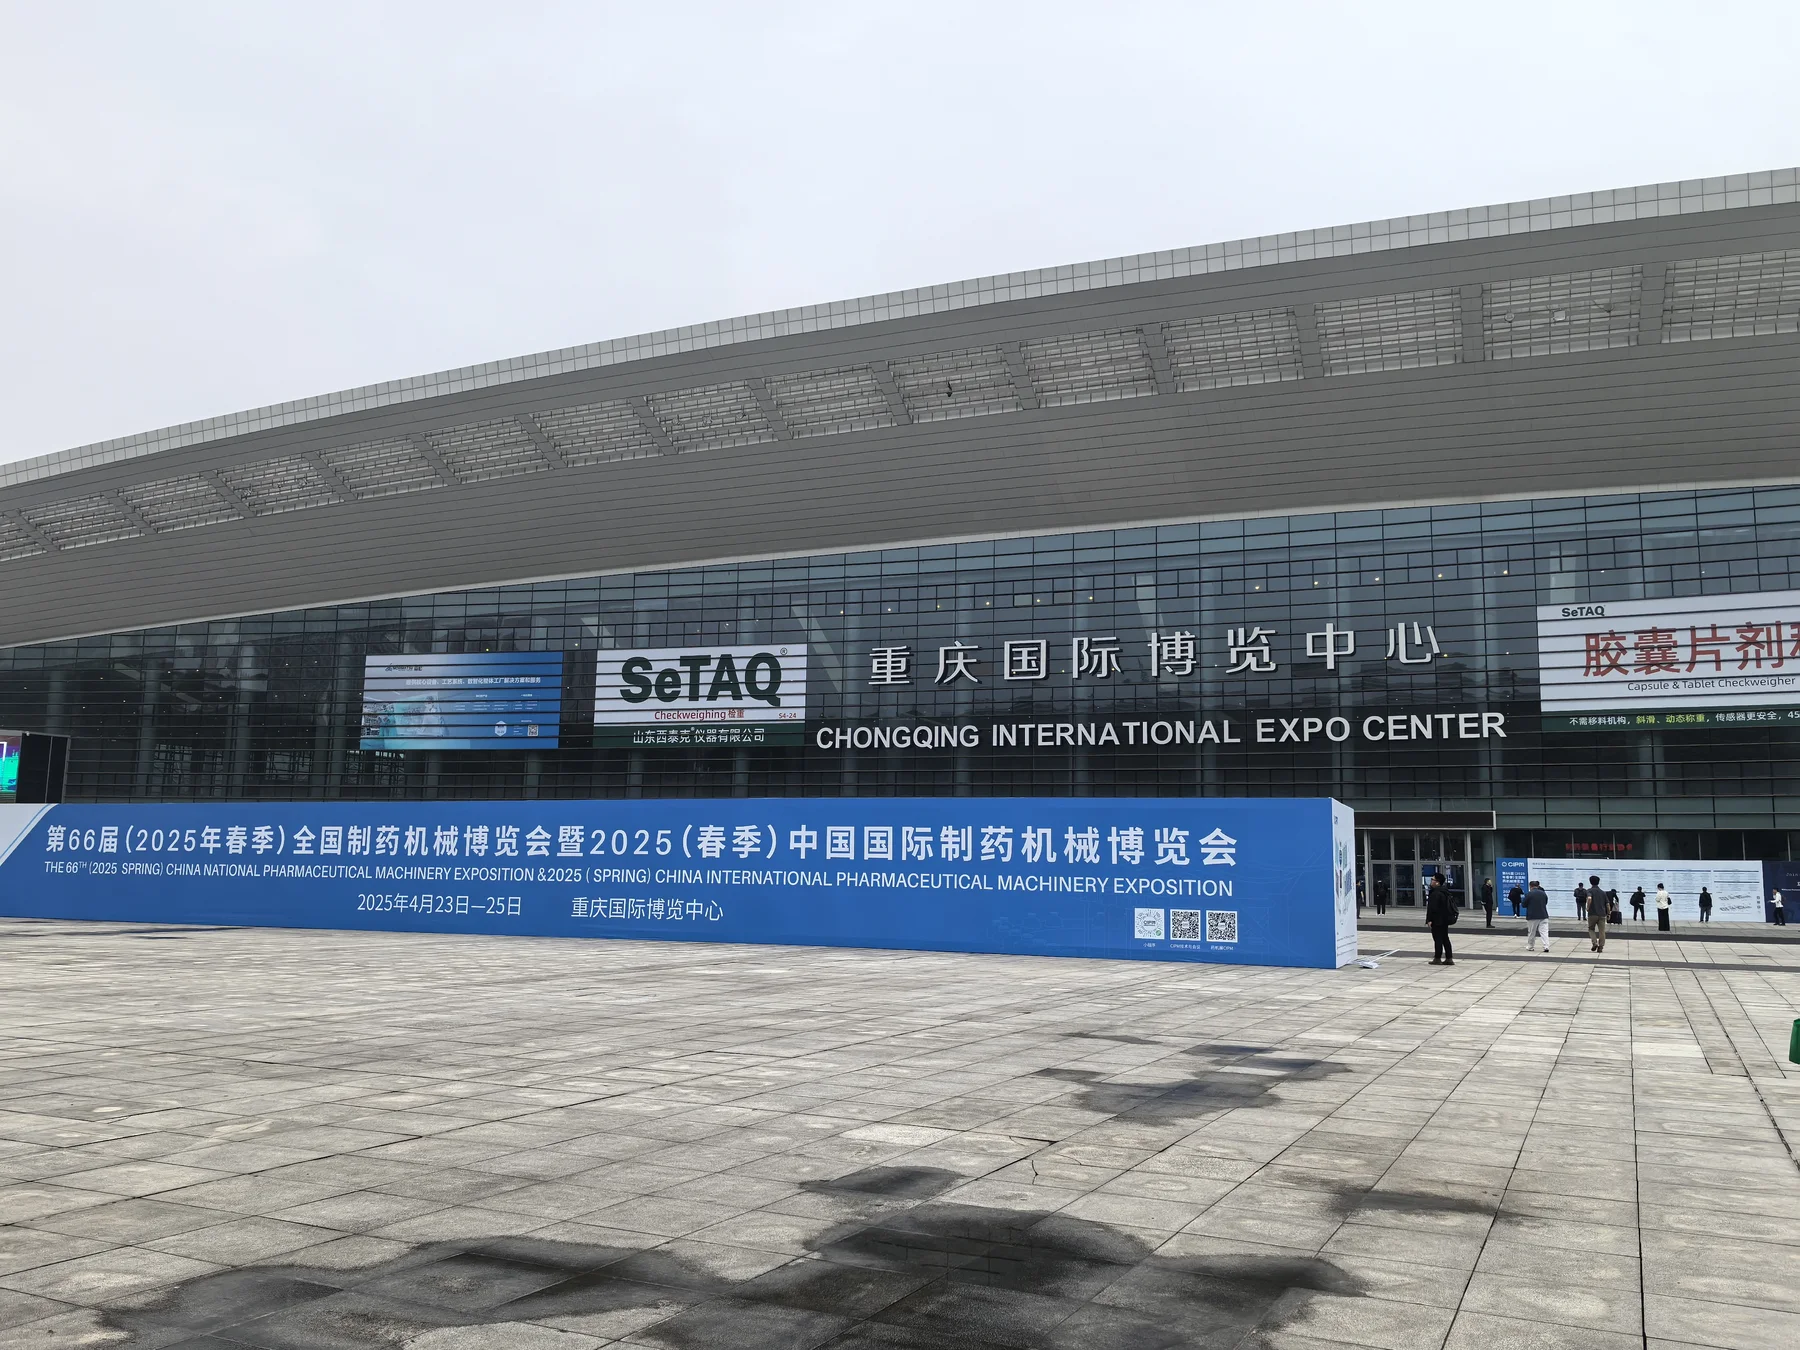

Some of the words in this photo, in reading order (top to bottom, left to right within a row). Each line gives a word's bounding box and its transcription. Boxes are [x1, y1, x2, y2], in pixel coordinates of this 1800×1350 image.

[1561, 605, 1605, 617] SeTAQ
[868, 621, 1441, 686] 重庆国际博览中心
[1583, 619, 1800, 677] 胶囊片剂
[1627, 680, 1670, 692] Capsule
[1672, 680, 1680, 690] &
[1682, 679, 1715, 689] Tablet
[1718, 676, 1796, 688] Checkweigher
[654, 708, 727, 721] Checkweighing
[728, 708, 745, 719] 检重
[816, 725, 980, 750] CHONGQING
[992, 720, 1241, 747] INTERNATIONAL
[1256, 716, 1351, 743] EXPO
[1362, 711, 1508, 741] CENTER
[44, 861, 65, 874] THE
[88, 861, 118, 875] (2025
[121, 862, 164, 877] SPRING)
[165, 863, 201, 876] CHINA
[203, 864, 260, 878] NATIONAL
[262, 864, 373, 880] PHARMACEUTICAL
[375, 866, 452, 881] MACHINERY
[454, 867, 535, 882] EXPOSITION
[655, 869, 703, 885] CHINA
[706, 869, 833, 887] INTERNATIONAL
[836, 872, 993, 891] PHARMACEUTICAL
[997, 873, 1109, 894] MACHINERY
[1113, 877, 1234, 897] EXPOSITION
[571, 896, 724, 921] 重庆国际博览中心
